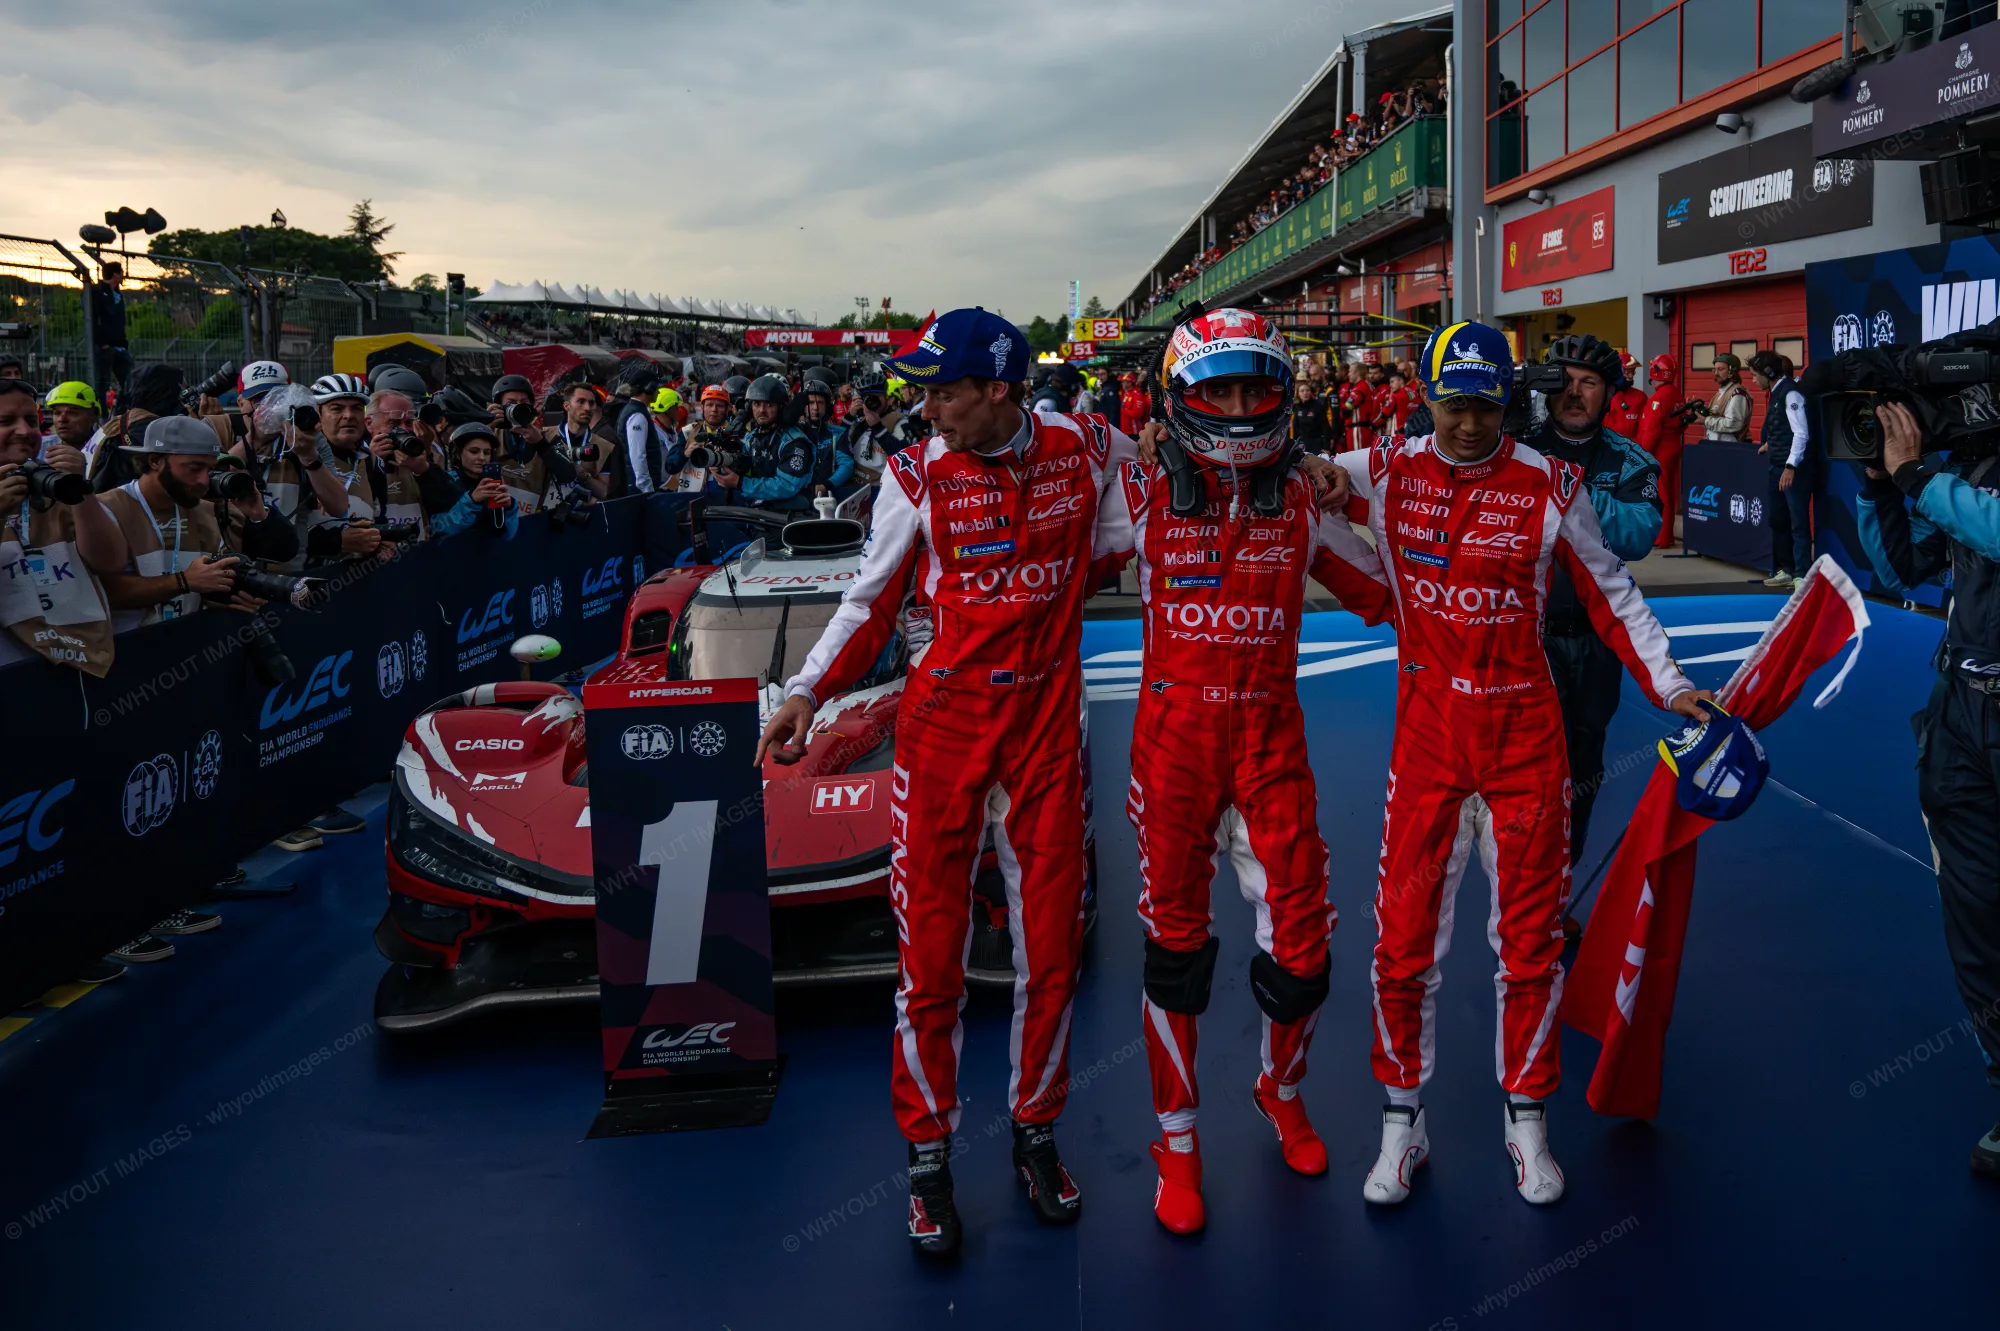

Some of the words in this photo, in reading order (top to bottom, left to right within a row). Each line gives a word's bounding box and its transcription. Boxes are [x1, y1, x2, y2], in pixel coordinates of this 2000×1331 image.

[1937, 72, 1990, 104] POMMERY
[1842, 107, 1885, 134] POMMERY
[1708, 168, 1794, 218] SCRUTINEERING
[1667, 197, 1691, 218] WEC
[1592, 220, 1604, 240] 83
[1728, 248, 1767, 275] TEC2
[765, 331, 815, 344] MOTUL
[841, 331, 891, 344] MTUL
[1094, 321, 1119, 337] 83
[1834, 322, 1862, 355] FIA
[1073, 343, 1094, 355] 51
[1181, 341, 1231, 366] TOYOTA
[1231, 342, 1288, 360] RACING
[1442, 362, 1496, 373] MICHELIN
[1196, 438, 1209, 449] BELL
[1216, 438, 1266, 451] DENSO
[1023, 455, 1080, 480] DENSO
[1458, 465, 1492, 475] TOYOTA
[678, 478, 690, 489] 25
[938, 472, 997, 494] FUJITSU
[1032, 479, 1069, 498] ZENT
[1401, 476, 1453, 498] FUJITSU
[949, 491, 1002, 510] AISIN
[1468, 488, 1535, 509] DENSO
[1688, 484, 1721, 507] WEC
[1027, 494, 1084, 521] WEC
[1401, 499, 1450, 518] AISIN
[1730, 499, 1745, 520] FIA
[950, 516, 995, 535] Mobil
[999, 516, 1007, 527] 1
[1478, 511, 1518, 528] ZENT
[1165, 525, 1219, 540] AISIN
[1248, 528, 1285, 541] ZENT
[1397, 521, 1433, 542] Mobil
[1440, 531, 1445, 542] 1
[1461, 530, 1529, 549] WEC
[971, 543, 1011, 554] MICHELIN
[1164, 550, 1205, 566] Mobil
[1210, 551, 1217, 562] 1
[1235, 546, 1296, 563] WEC
[1410, 553, 1444, 565] MICHELIN
[581, 555, 623, 597] WEC
[742, 571, 855, 585] DENSO
[959, 556, 1075, 592] TOYOTA
[38, 594, 53, 610] 5
[1403, 573, 1524, 612] TOYOTA
[457, 588, 515, 644] WEC
[532, 594, 548, 621] FIA
[1161, 602, 1285, 631] TOYOTA
[1407, 599, 1524, 626] RACING
[1164, 629, 1282, 645] RACING
[50, 647, 88, 663] IMOLA
[458, 651, 467, 662] FIA
[468, 643, 487, 658] WORLD
[458, 649, 498, 672] CHAMPIONSHIP
[378, 651, 400, 695] FIA
[259, 649, 353, 730] WEC
[629, 686, 713, 699] HYPERCAR
[259, 738, 275, 755] FIA
[276, 725, 308, 746] WORLD
[308, 706, 353, 733] ENDURANCE
[259, 731, 324, 768] CHAMPIONSHIP
[455, 739, 525, 751] CASIO
[625, 733, 668, 752] FIA
[126, 767, 173, 827] FIA
[470, 784, 522, 792] MARELLI
[815, 784, 869, 808] HY
[890, 761, 910, 946] DENSO
[639, 800, 719, 985] 1
[642, 1021, 736, 1048] WEC
[642, 1051, 655, 1059] FIA
[657, 1049, 681, 1057] WORLD
[683, 1047, 731, 1055] ENDURANCE
[642, 1055, 701, 1065] CHAMPIONSHIP
